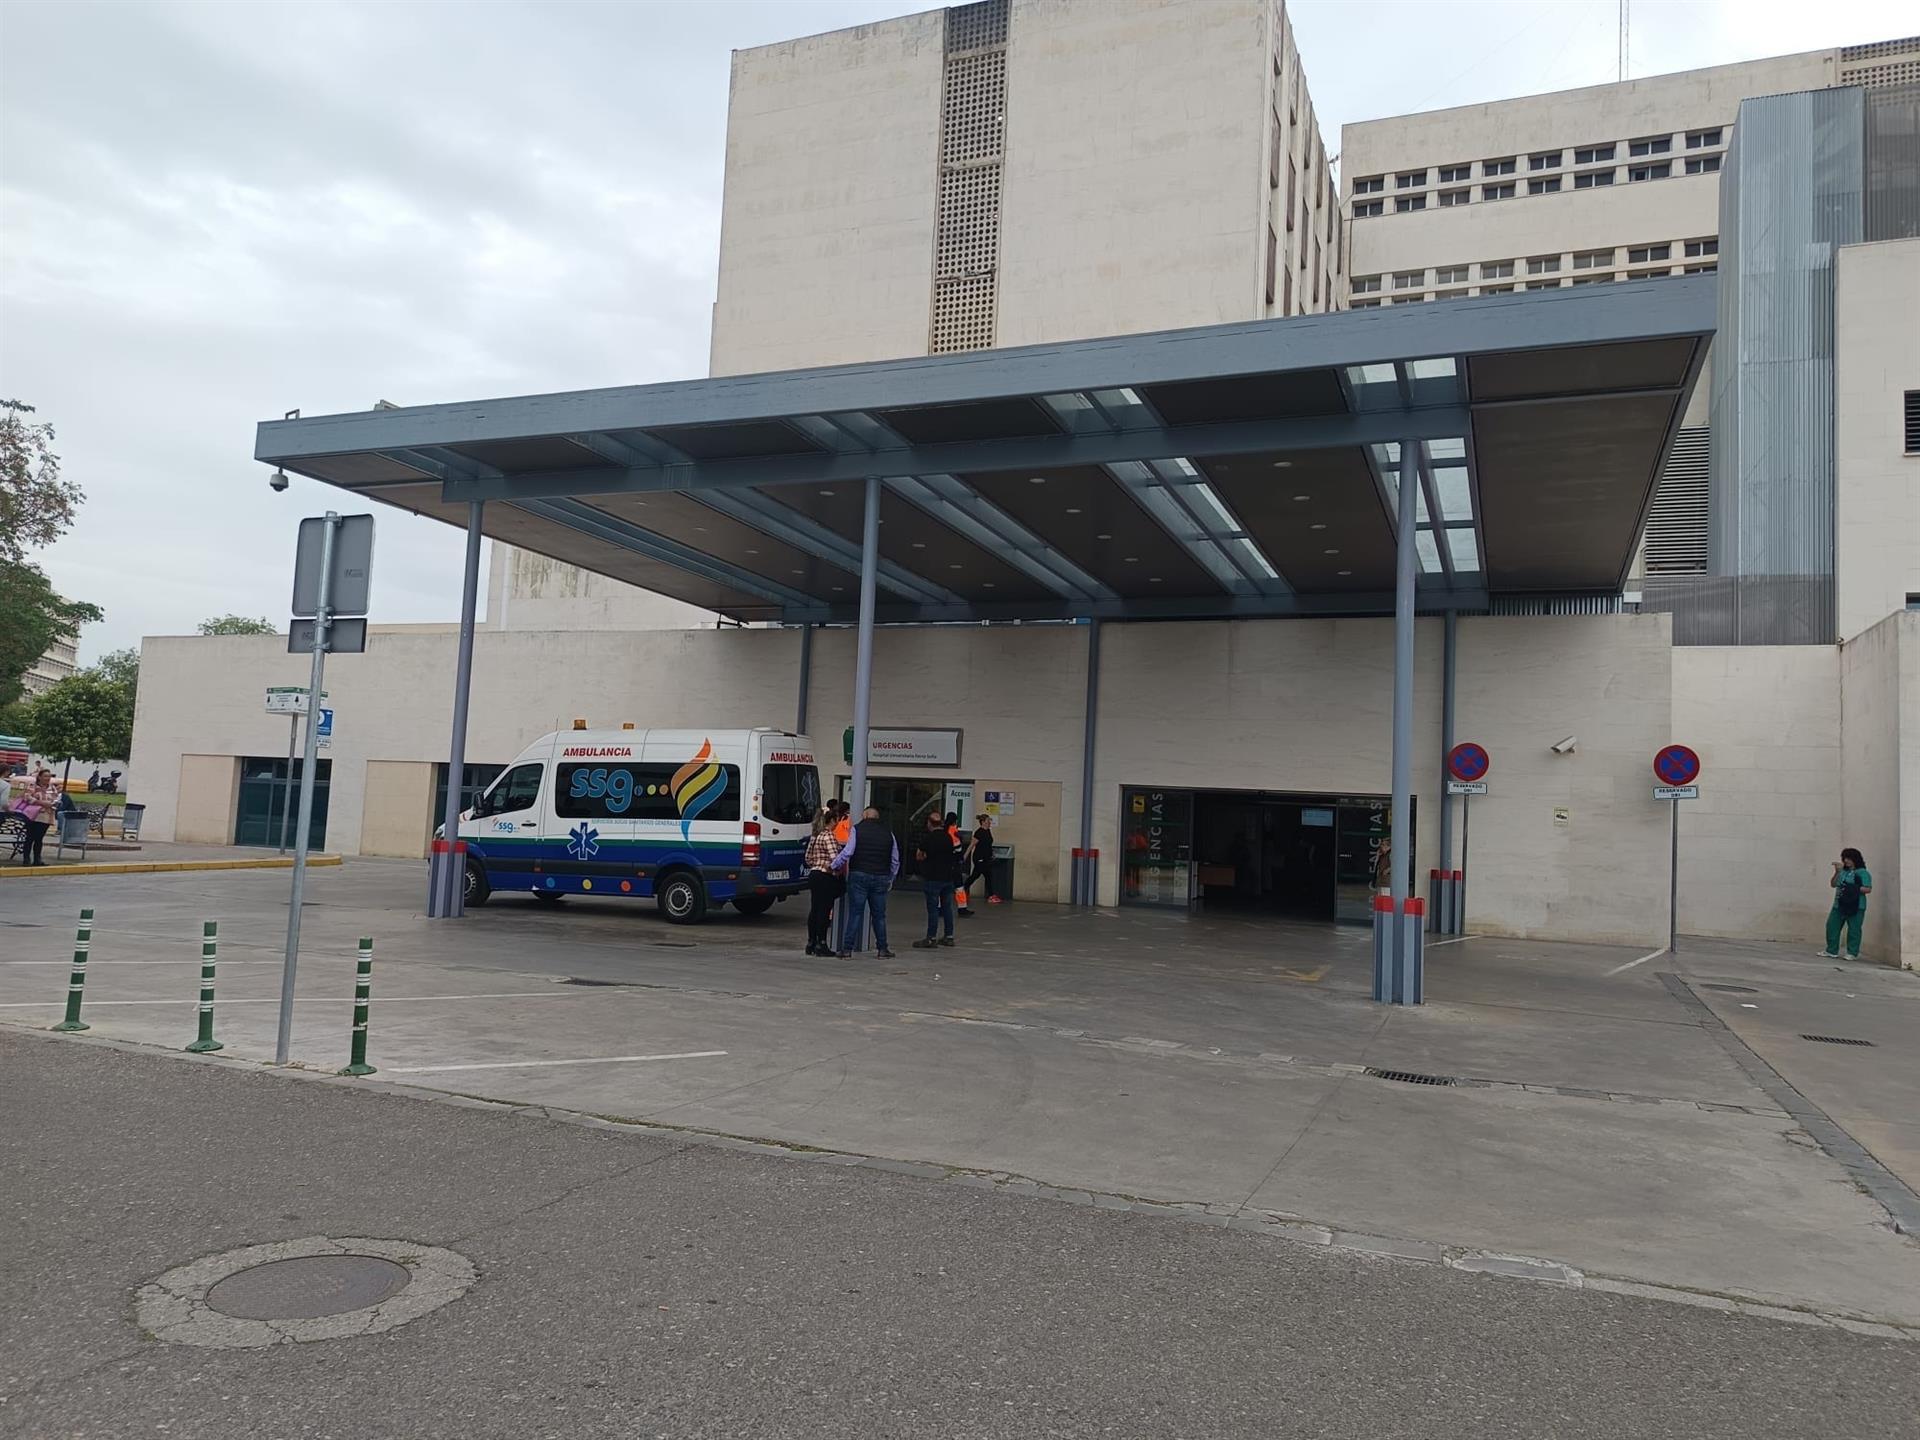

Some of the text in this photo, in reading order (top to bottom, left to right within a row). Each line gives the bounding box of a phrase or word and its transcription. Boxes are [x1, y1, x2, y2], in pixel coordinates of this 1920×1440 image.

[872, 742, 913, 750] URGENCIAS
[562, 747, 632, 757] AMBULANCIA
[770, 752, 814, 763] AMBULANCIA
[570, 768, 633, 813] ssg
[950, 789, 971, 797] Acceso
[498, 822, 513, 833] ssg
[1148, 791, 1164, 903] URGENCIAS
